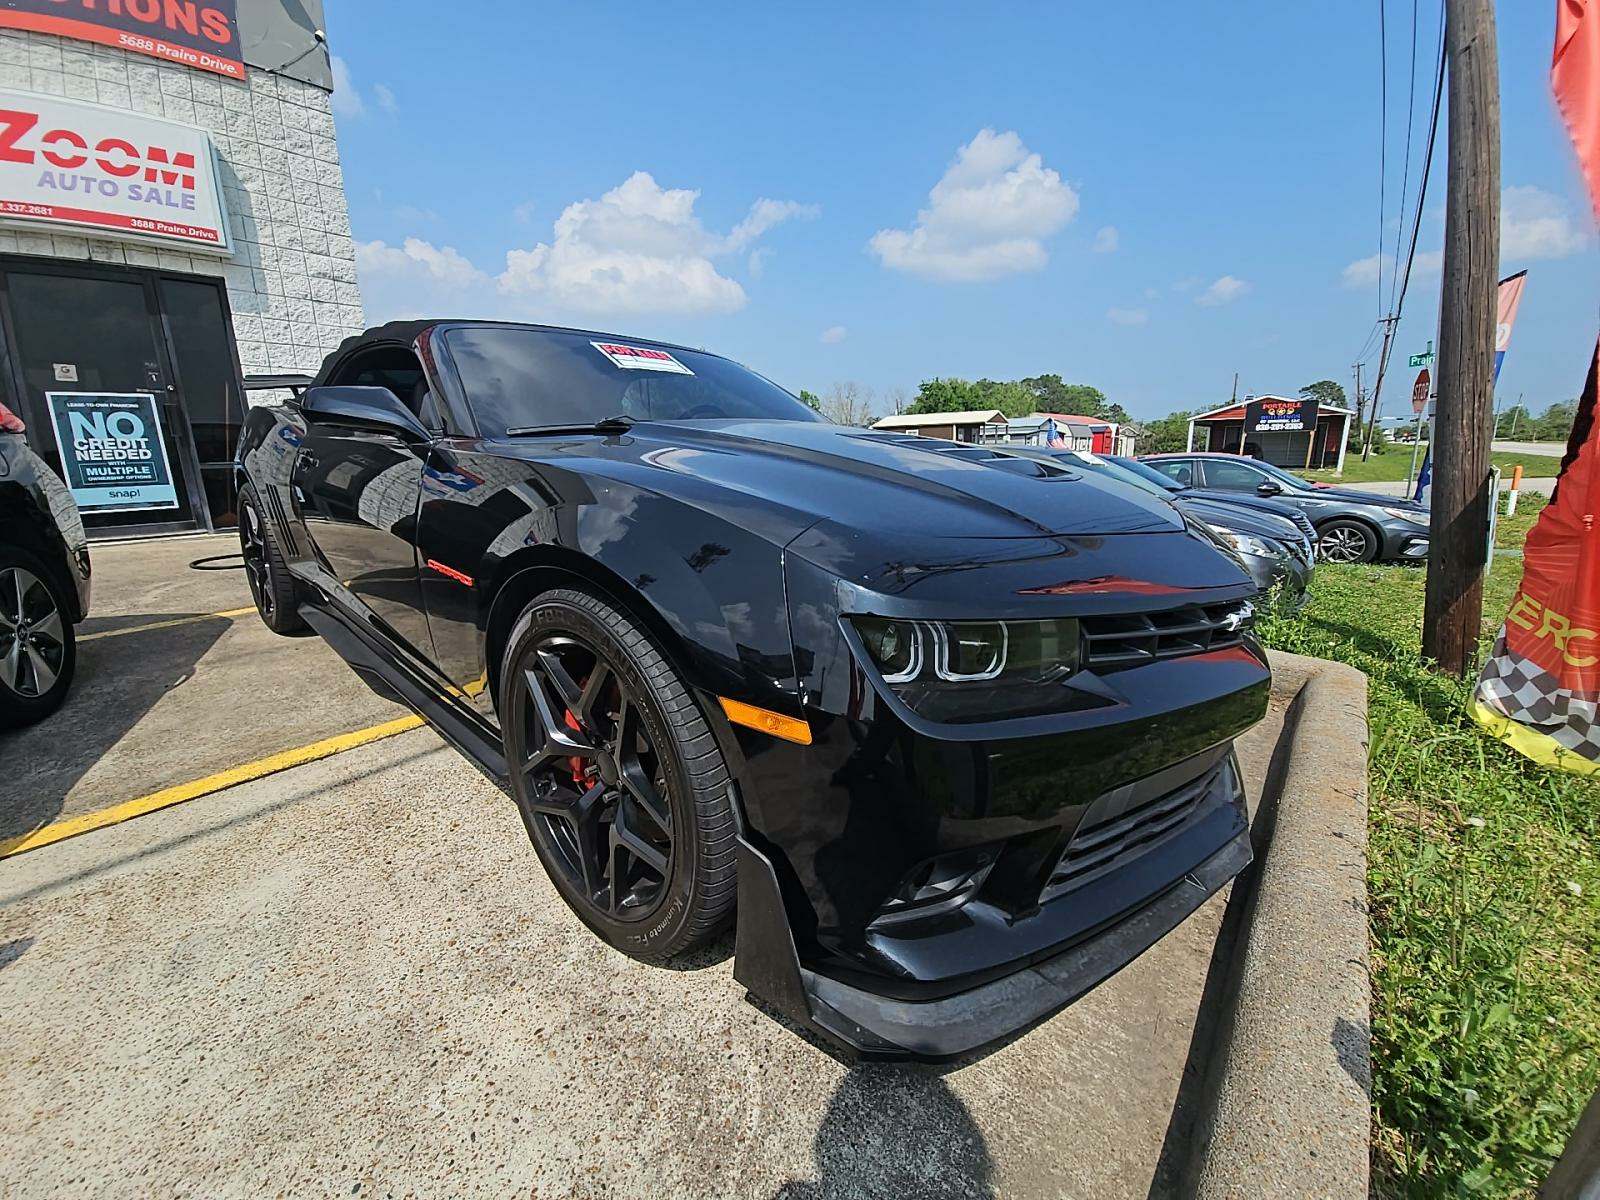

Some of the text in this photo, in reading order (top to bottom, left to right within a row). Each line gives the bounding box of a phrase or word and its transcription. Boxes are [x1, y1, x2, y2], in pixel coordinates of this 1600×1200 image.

[118, 33, 238, 75] 3688 Praire Drive.
[0, 109, 195, 190] ZOOM
[36, 170, 196, 211] AUTO SALE
[130, 218, 155, 230] 3688
[602, 344, 636, 356] FOR
[1413, 382, 1430, 400] STOP
[68, 411, 145, 440] NO
[74, 437, 149, 450] CREDIT
[75, 448, 152, 461] NEEDED
[86, 466, 151, 476] MULTIPLE
[108, 489, 141, 499] snap!
